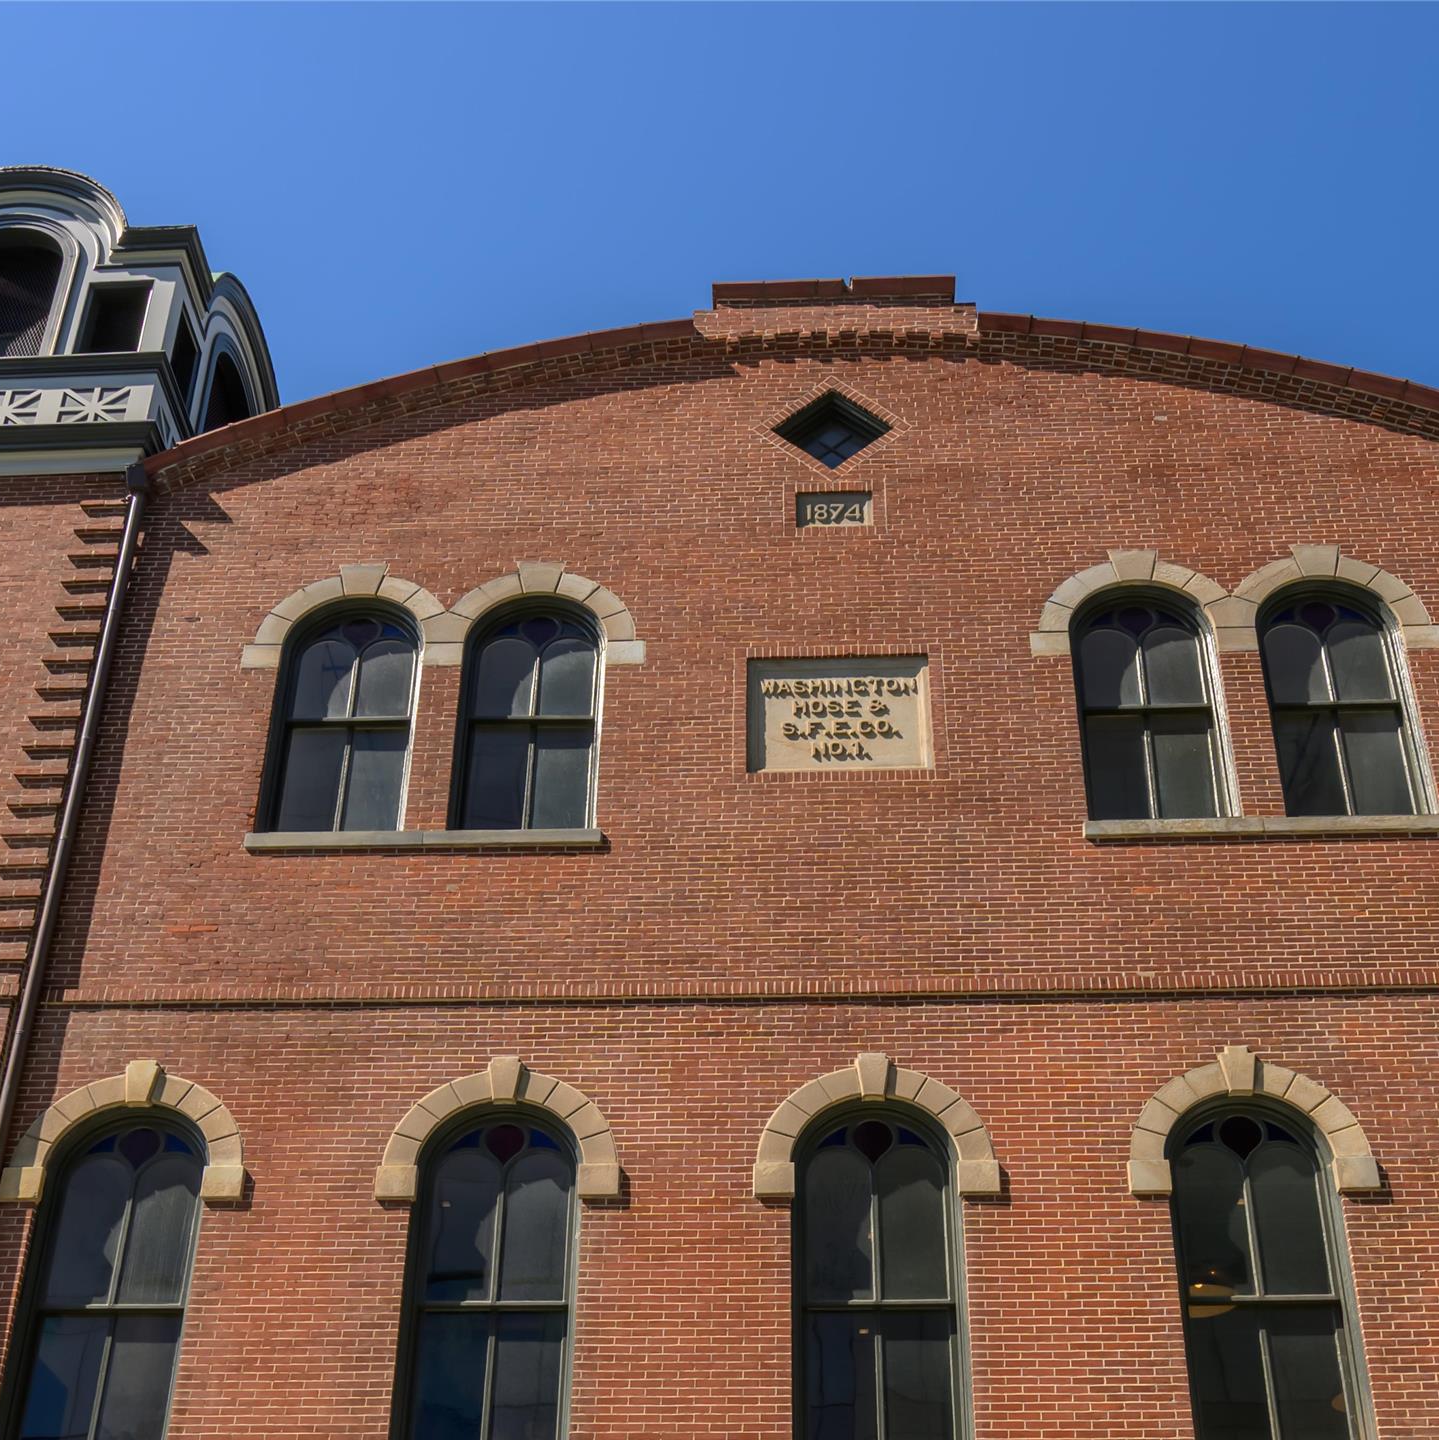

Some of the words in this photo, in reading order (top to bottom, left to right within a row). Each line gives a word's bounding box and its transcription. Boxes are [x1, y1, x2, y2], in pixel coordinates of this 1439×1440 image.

[805, 503, 861, 520] 1874
[760, 678, 918, 697] WASHINGTON
[792, 699, 861, 716] HOSE
[868, 699, 889, 715] &
